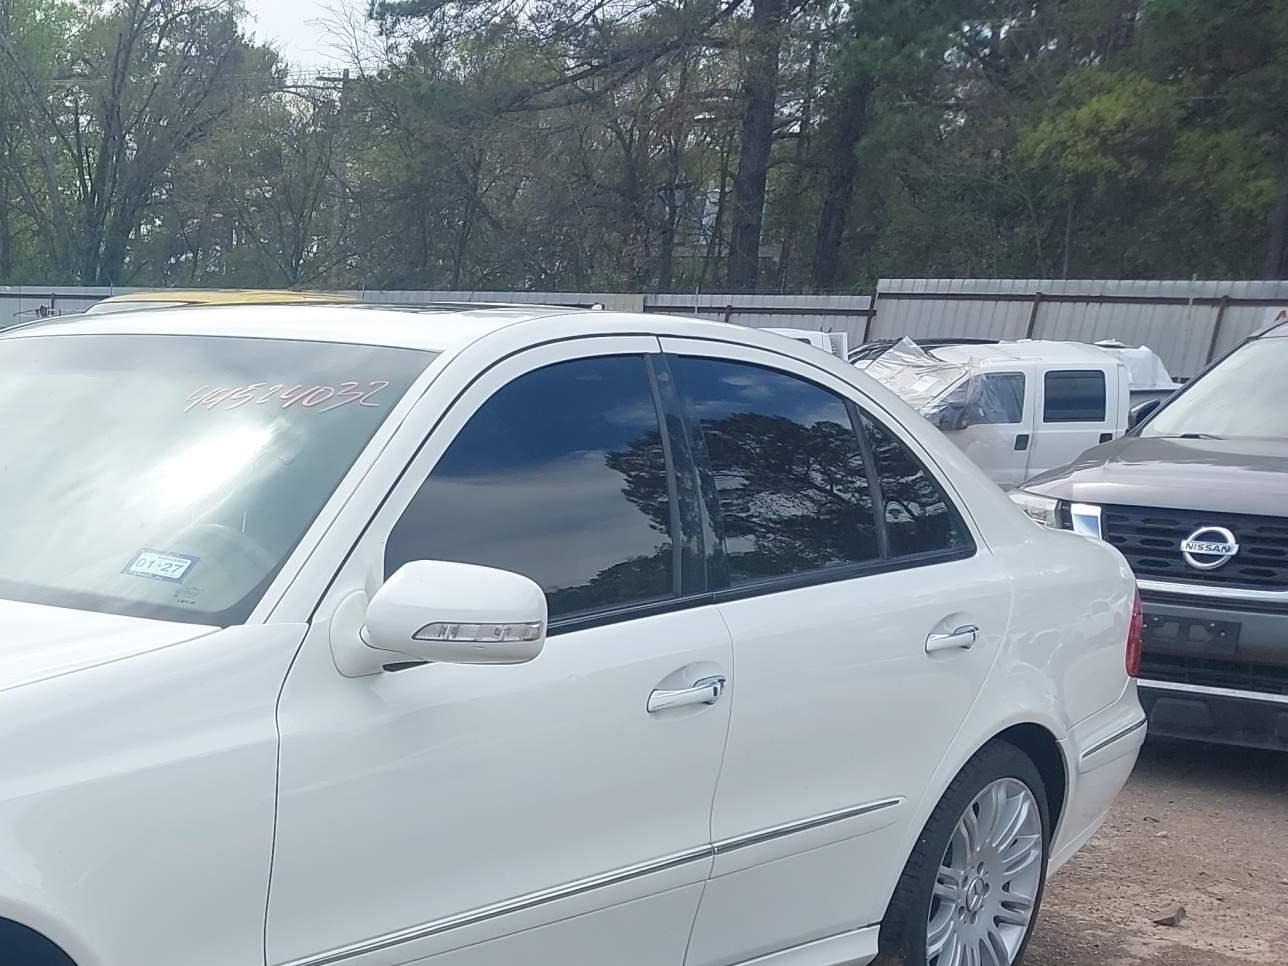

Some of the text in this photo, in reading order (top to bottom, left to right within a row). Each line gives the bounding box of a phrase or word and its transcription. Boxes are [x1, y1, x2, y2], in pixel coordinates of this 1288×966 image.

[184, 381, 389, 413] 44524032
[1185, 543, 1231, 553] NISSAN
[135, 558, 156, 569] 01
[159, 562, 185, 574] 27
